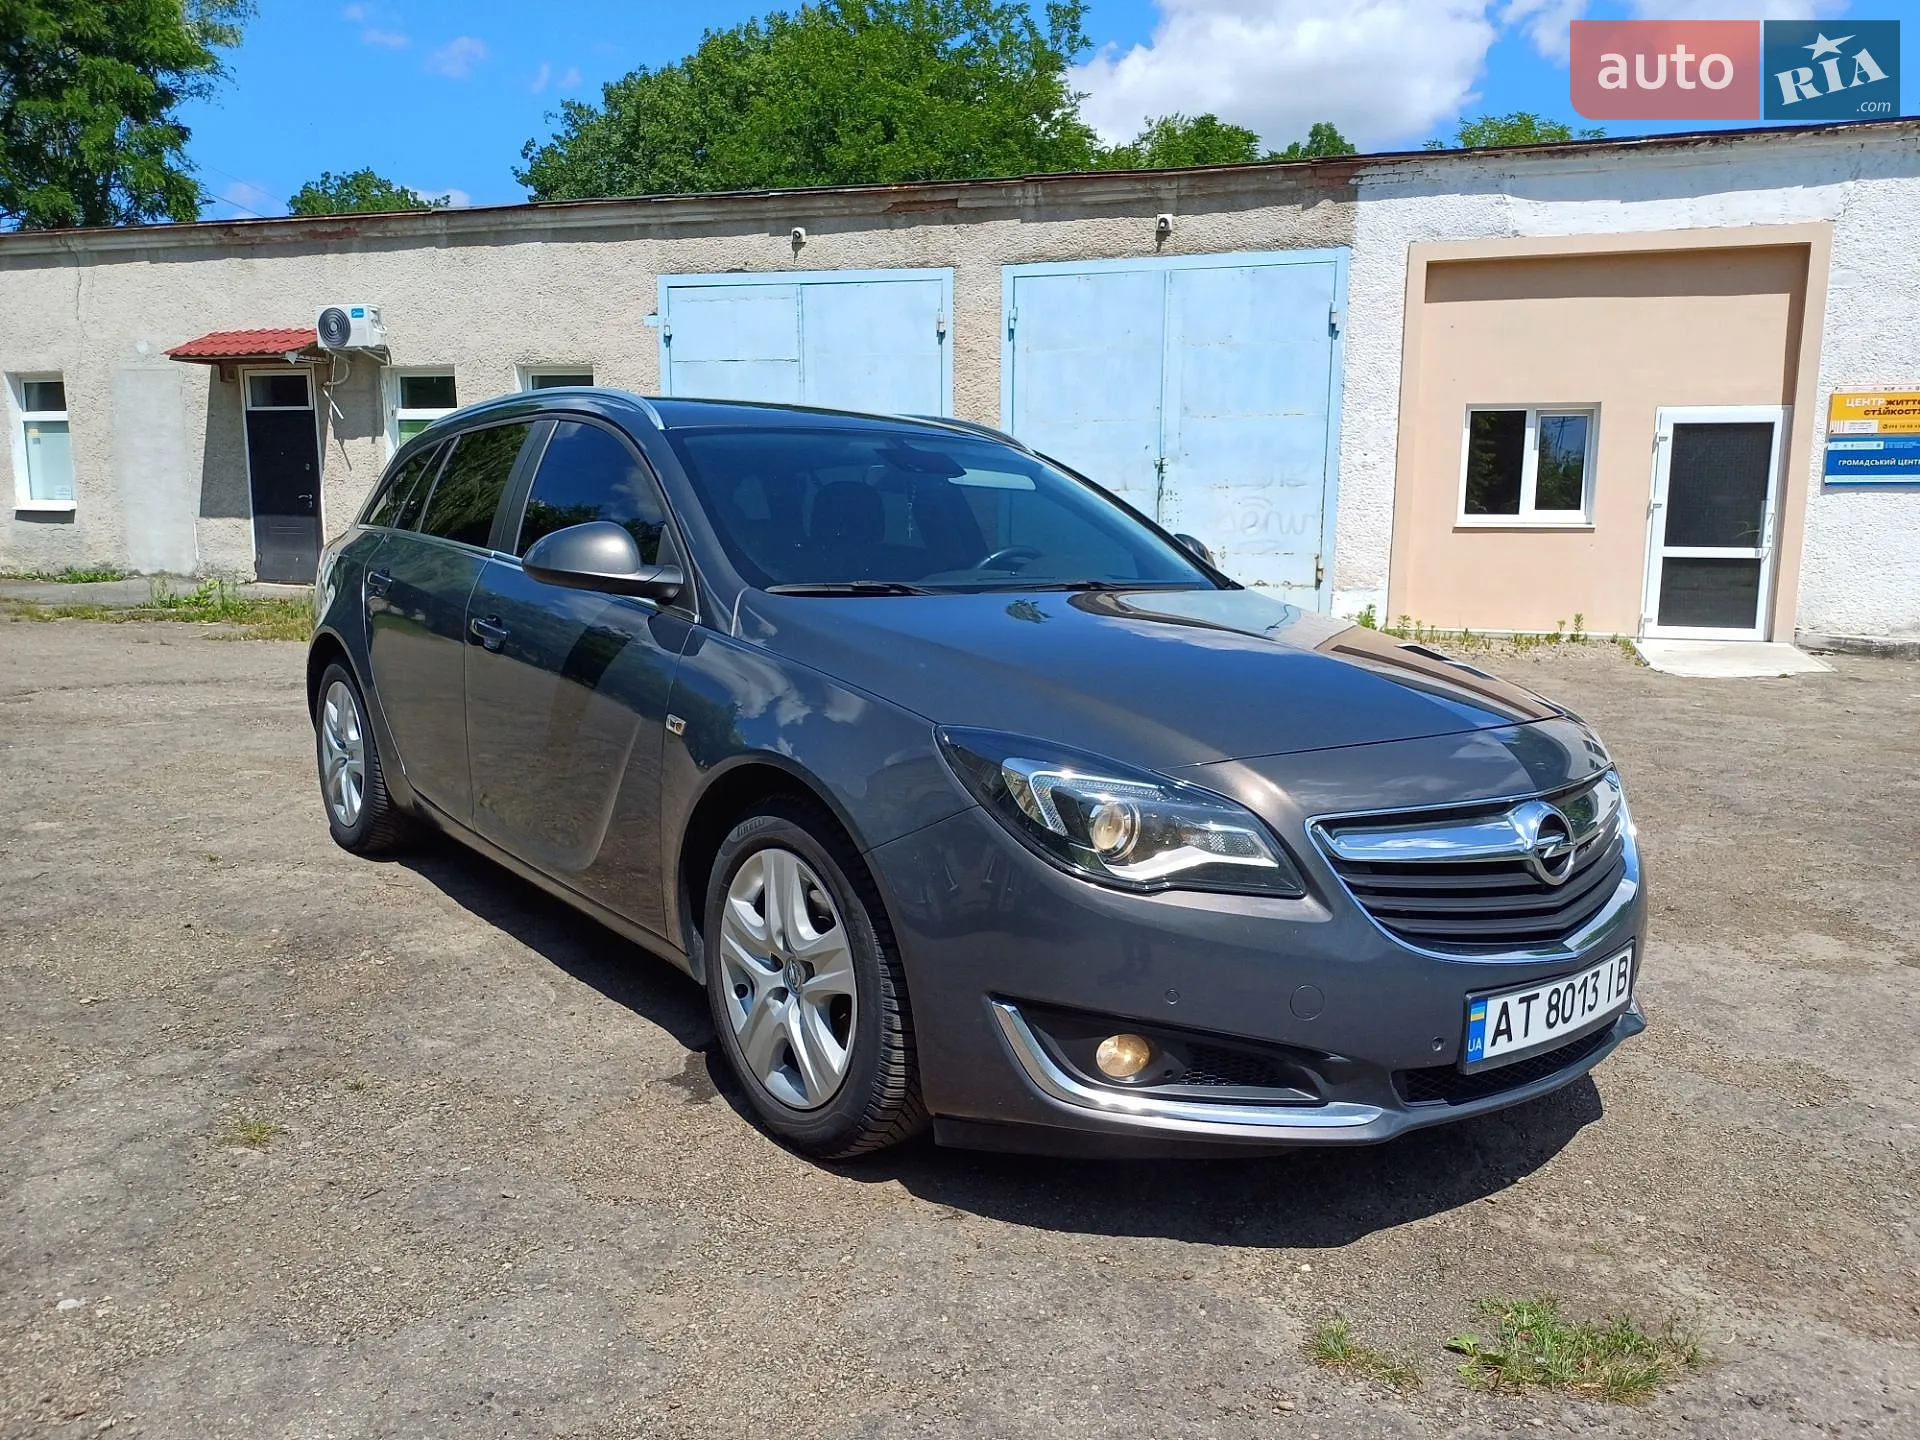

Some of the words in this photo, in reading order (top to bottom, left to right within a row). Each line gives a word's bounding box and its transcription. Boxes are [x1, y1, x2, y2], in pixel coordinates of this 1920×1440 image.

[1846, 398, 1885, 407] ЦЕНТР
[1838, 458, 1896, 466] ГРОМАДСЬКИЙ
[1490, 993, 1540, 1048] AT
[1545, 970, 1601, 1030] 8013
[1606, 956, 1628, 1003] IB
[1468, 1037, 1483, 1052] UA
